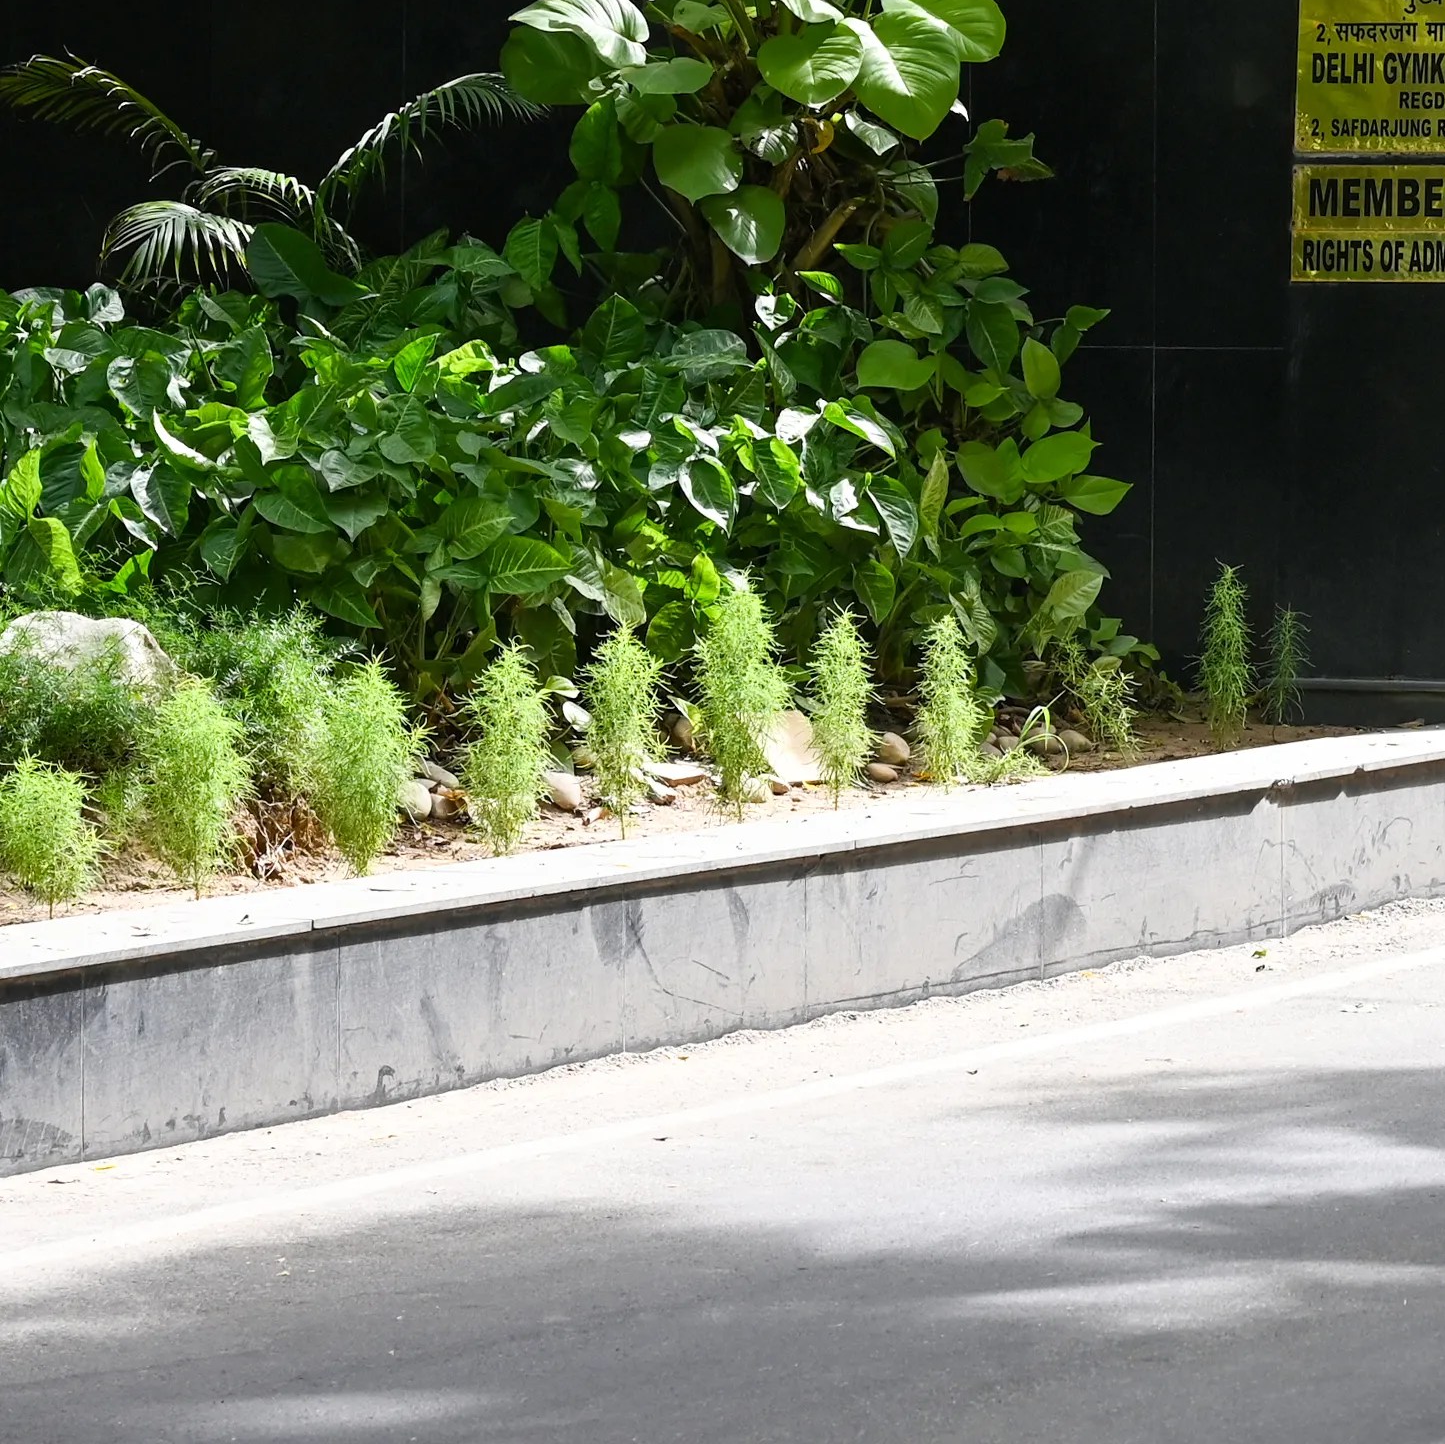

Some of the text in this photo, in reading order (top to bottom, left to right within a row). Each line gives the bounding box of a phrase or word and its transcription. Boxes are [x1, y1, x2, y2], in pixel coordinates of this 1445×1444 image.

[1312, 52, 1374, 84] DELHI
[1311, 119, 1325, 141] 2,
[1331, 119, 1432, 138] SAFDARJUNG
[1302, 239, 1373, 272] RIGHTS
[1380, 240, 1405, 272] OF
